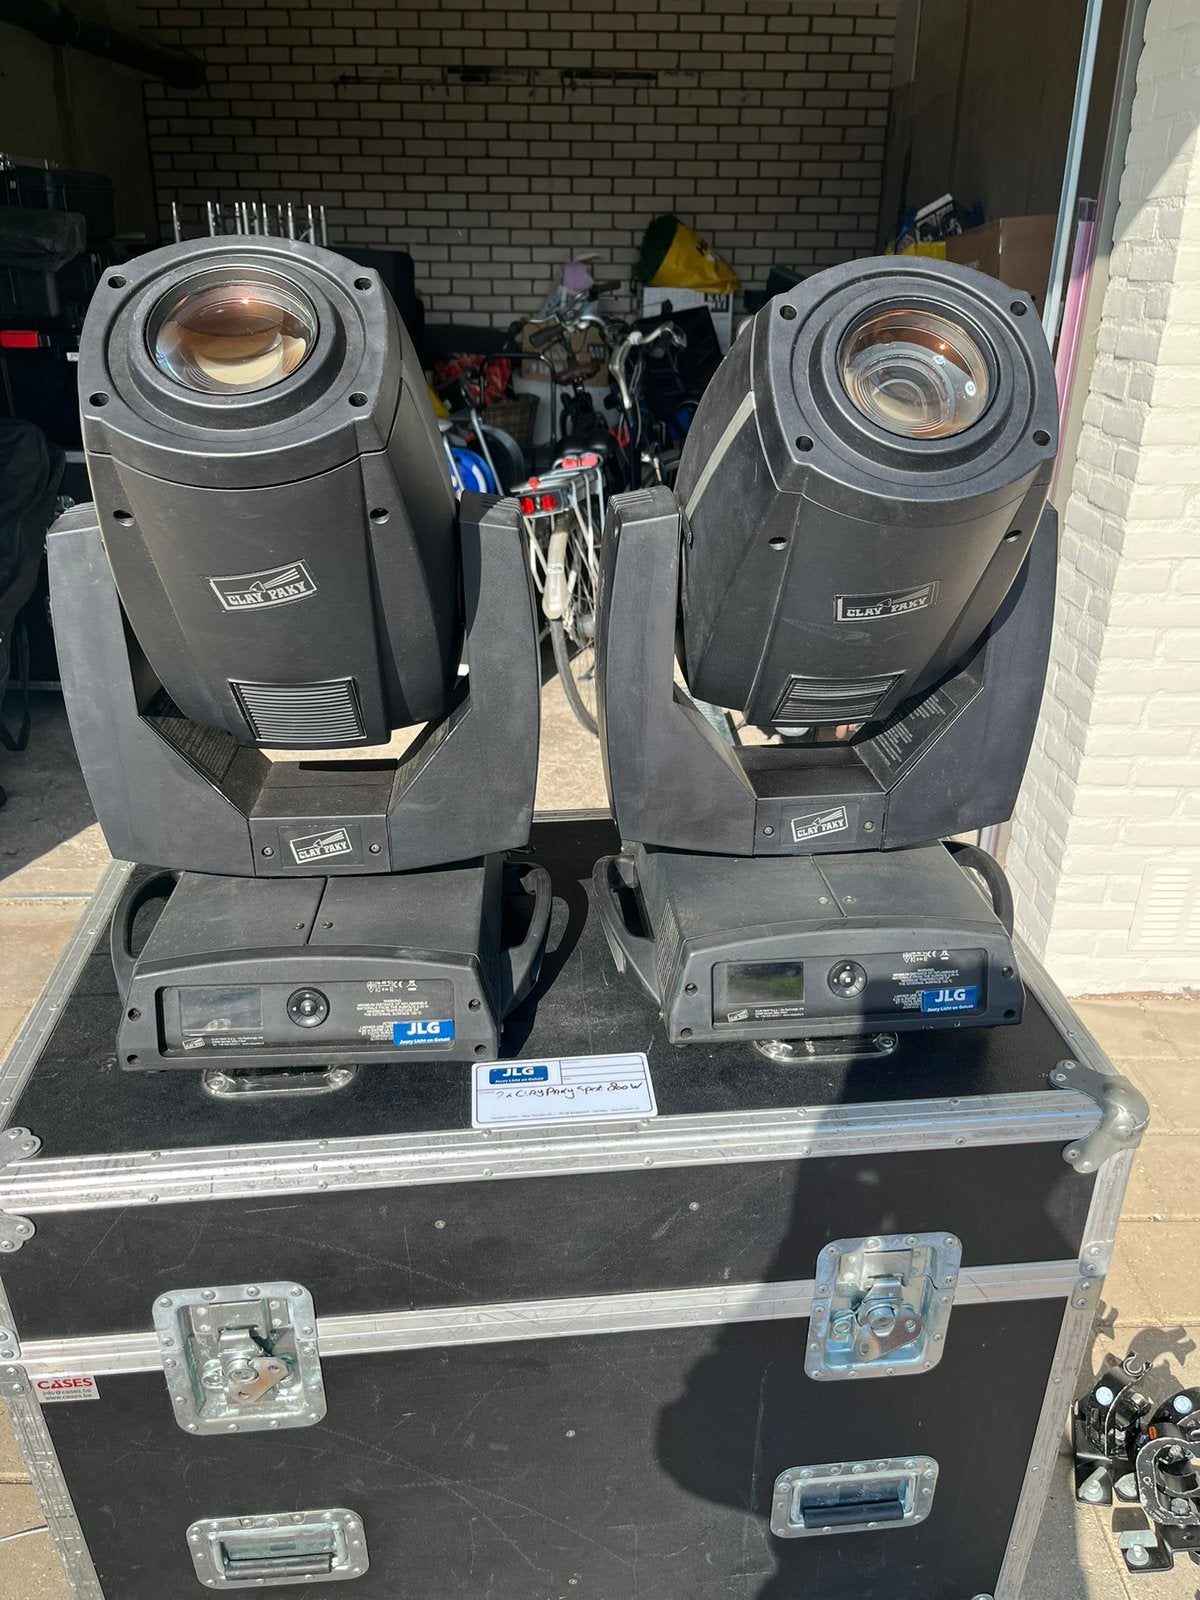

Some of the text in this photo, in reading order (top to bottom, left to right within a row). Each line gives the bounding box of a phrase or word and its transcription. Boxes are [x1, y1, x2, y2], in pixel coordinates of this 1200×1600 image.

[226, 581, 307, 606] CLAY PAKY
[846, 596, 928, 618] CLAY PAKY
[797, 819, 845, 838] CLAY PAKY
[298, 841, 348, 860] CLAY PAKY
[935, 988, 966, 1003] JLG
[406, 1021, 440, 1035] JLG
[502, 1066, 535, 1077] JLG
[37, 1377, 93, 1390] CASES
